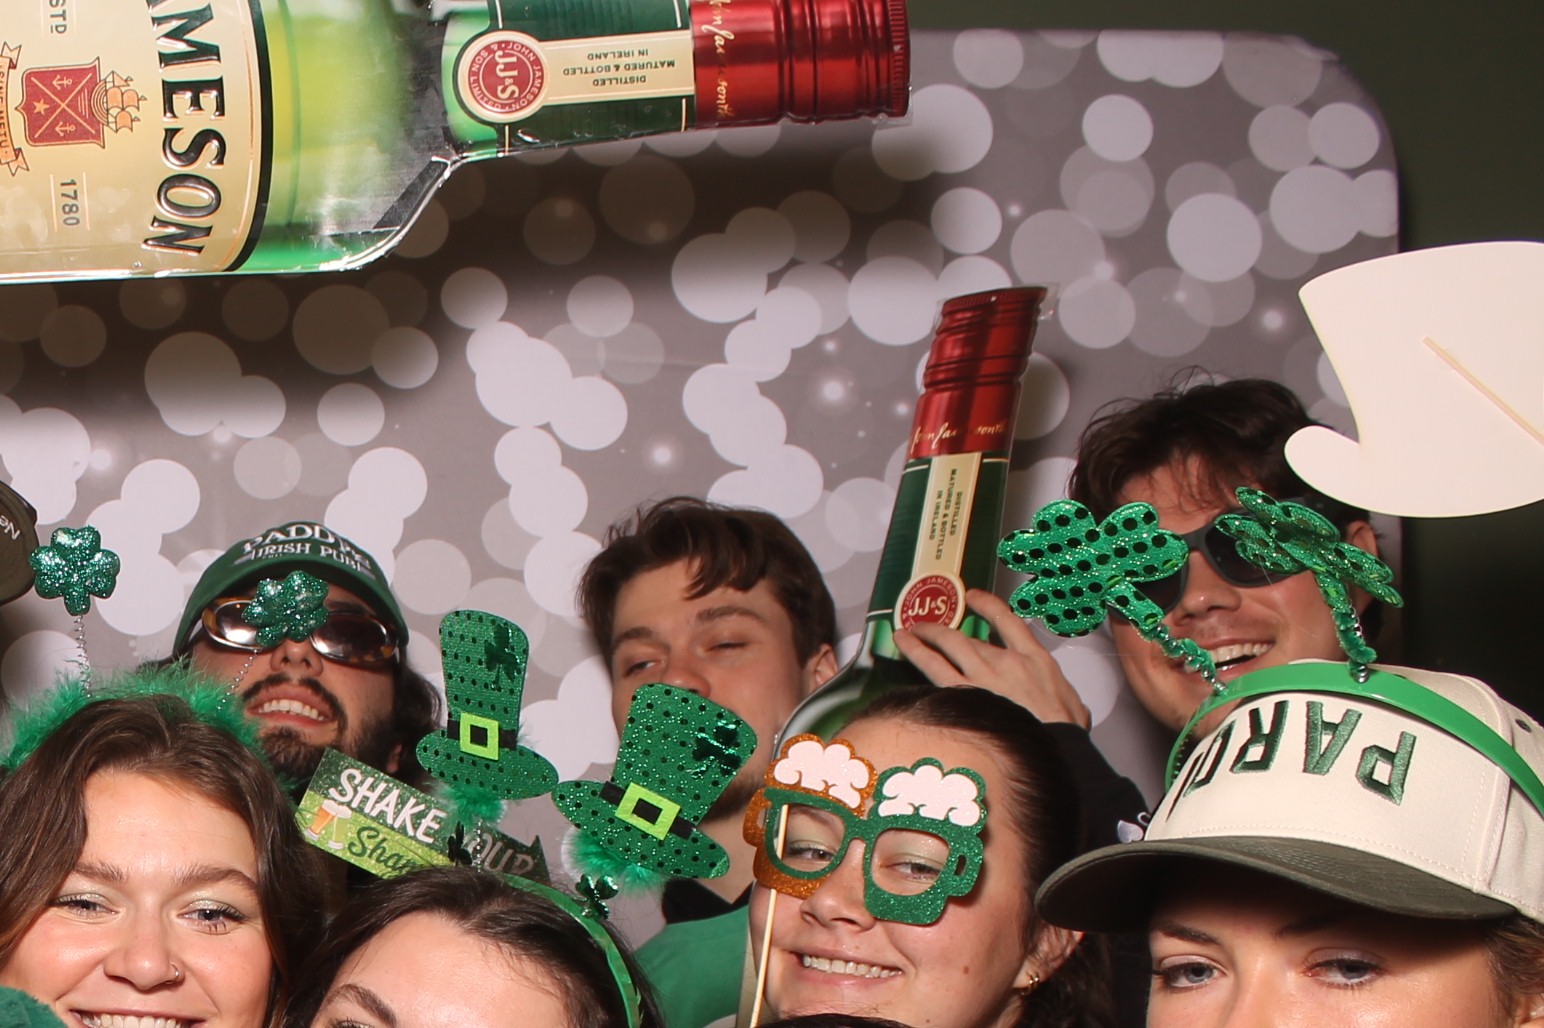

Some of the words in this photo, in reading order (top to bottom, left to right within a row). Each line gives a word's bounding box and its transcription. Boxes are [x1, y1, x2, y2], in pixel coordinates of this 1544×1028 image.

[472, 50, 488, 72] SON
[507, 42, 536, 61] JOHN
[587, 50, 634, 60] IRELAND
[638, 48, 648, 56] IN
[494, 50, 520, 100] JJ&S
[562, 64, 611, 76] BOTTLED
[613, 64, 621, 72] &
[624, 60, 676, 72] MATURED
[592, 75, 647, 86] DISTILLED
[141, 0, 226, 256] MESON
[59, 179, 80, 226] 1780
[936, 490, 943, 499] IN
[944, 468, 957, 510] MATURED
[929, 502, 941, 540] IRELAND
[950, 491, 963, 536] DISTILLED
[257, 542, 312, 558] IRISH
[936, 520, 948, 560] BOTTLED
[328, 768, 448, 844] SHAKE
[464, 832, 534, 875] OUR
